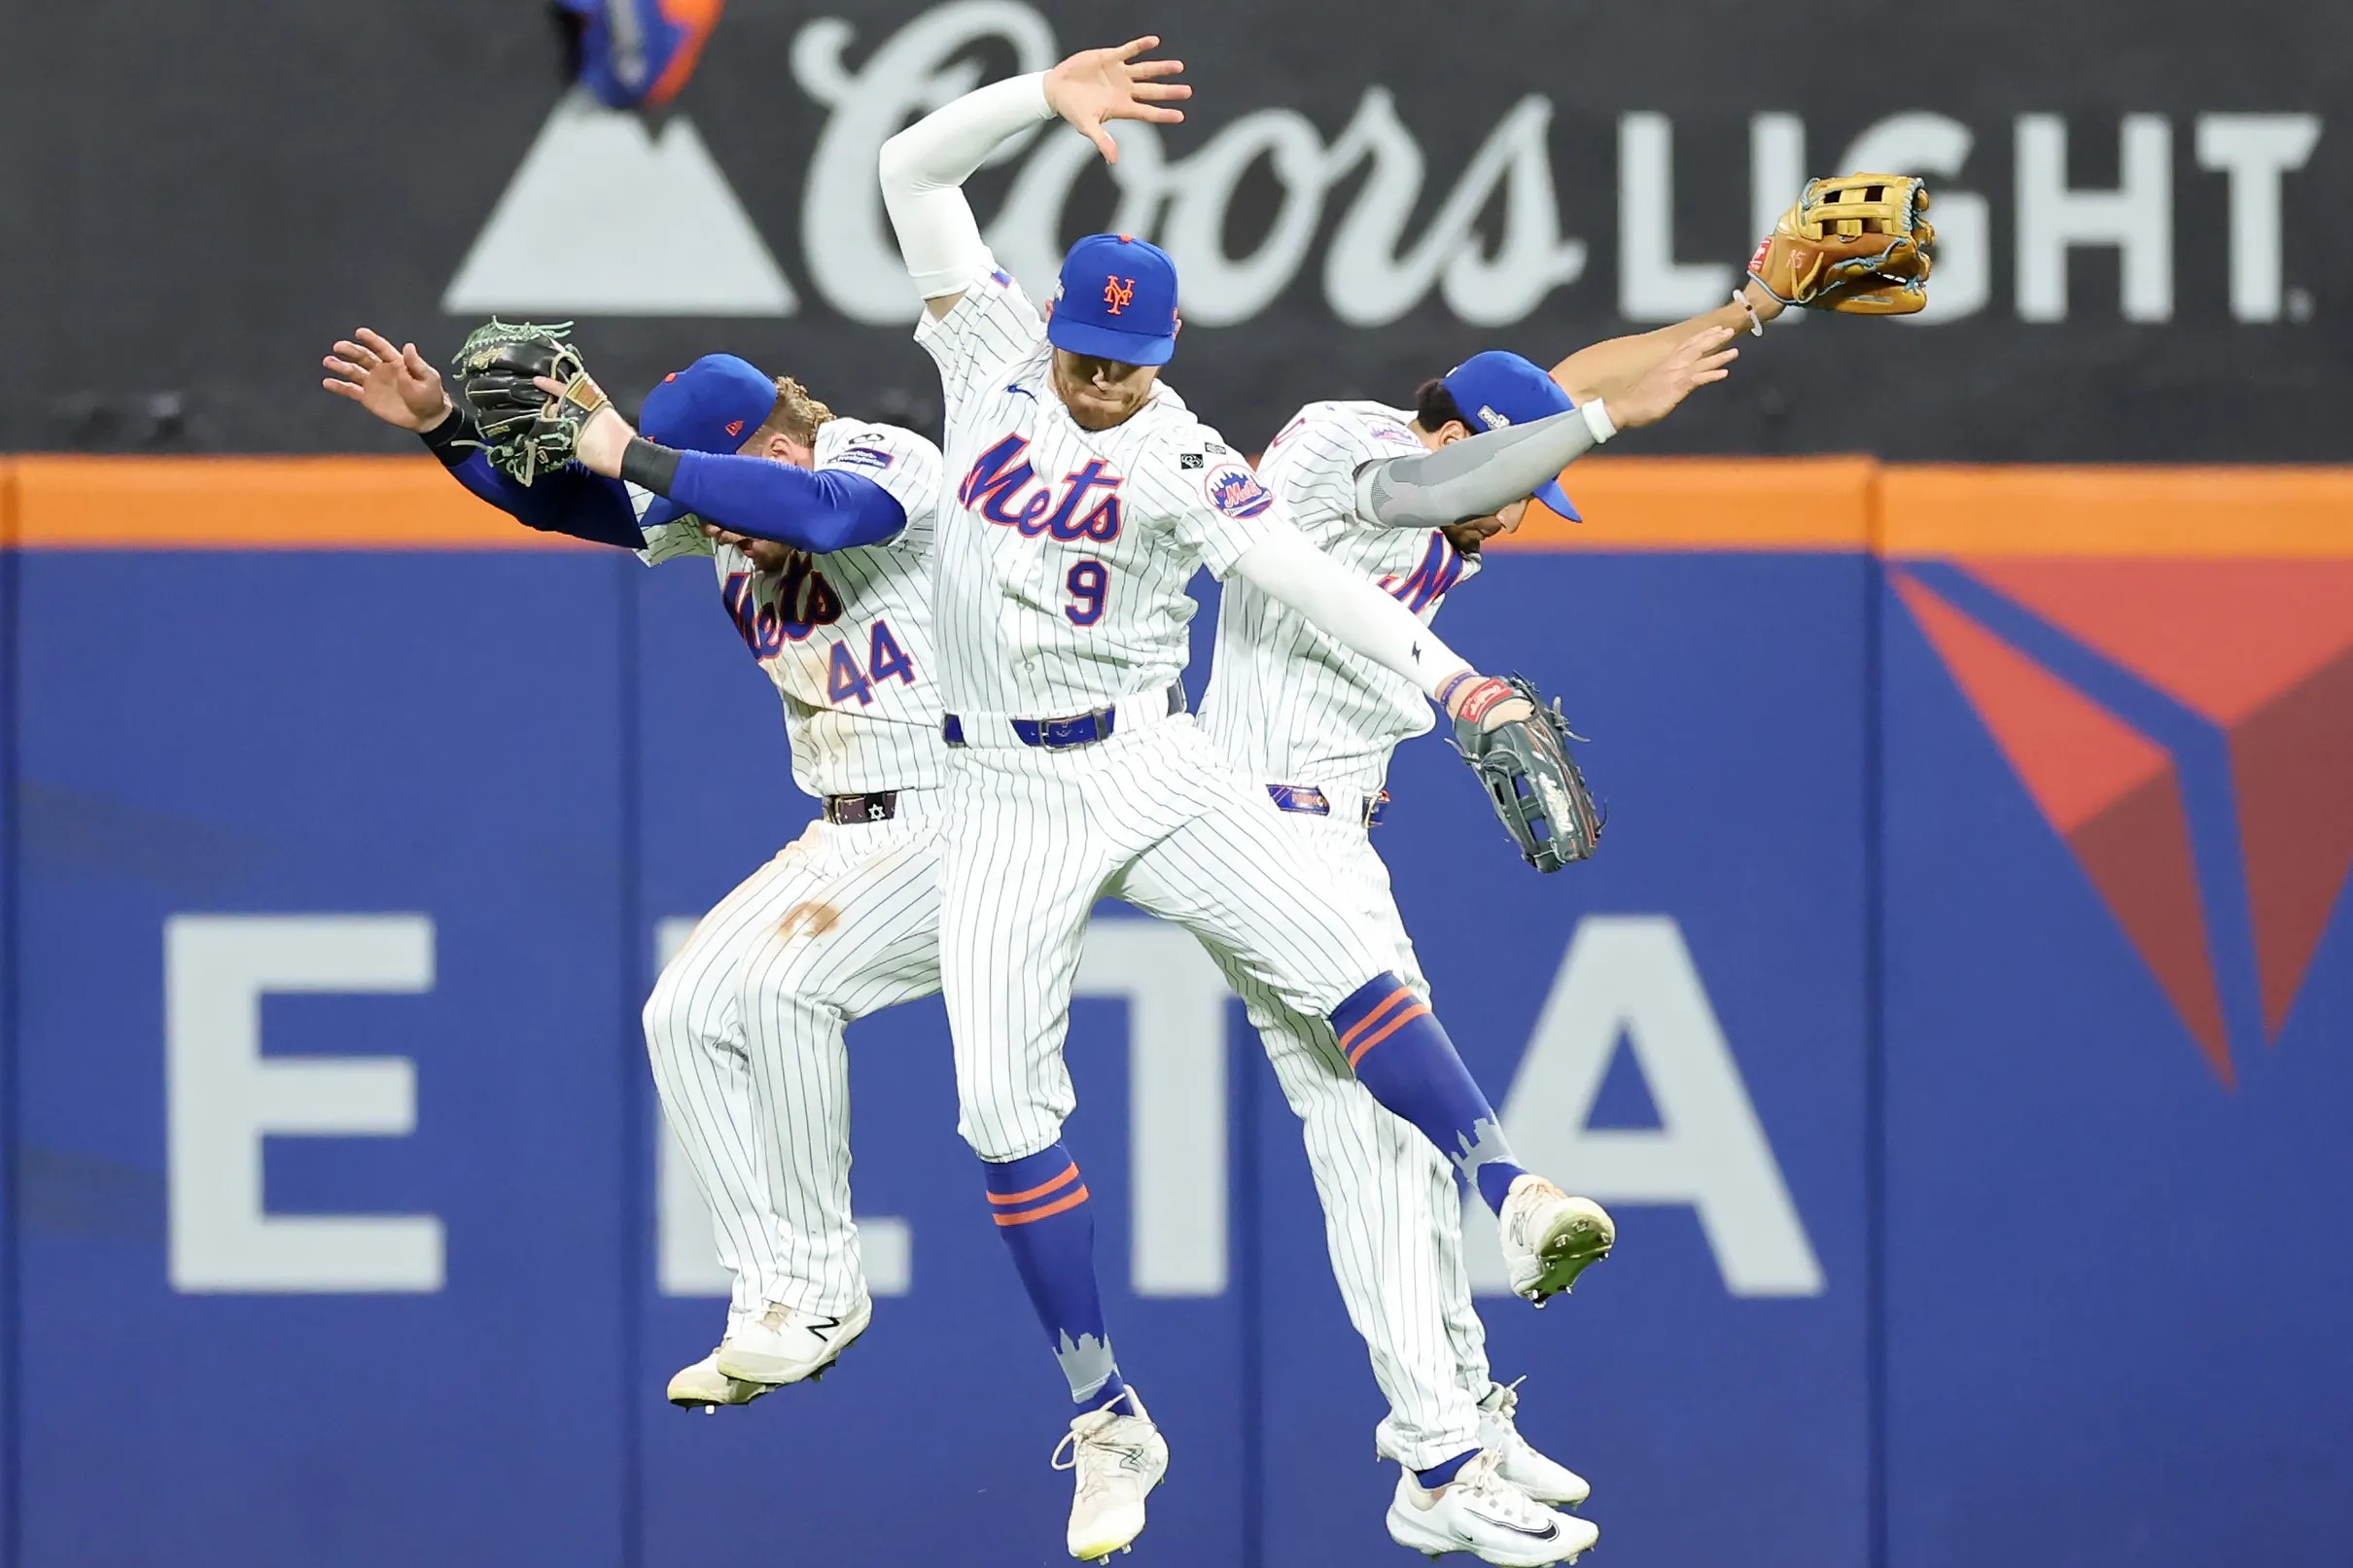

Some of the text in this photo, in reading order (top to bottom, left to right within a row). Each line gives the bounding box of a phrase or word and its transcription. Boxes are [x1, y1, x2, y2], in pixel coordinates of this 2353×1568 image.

[790, 0, 2322, 327] Coors LIGHT
[957, 432, 1125, 542] Mets
[1065, 560, 1108, 627] 9
[827, 619, 916, 707] 44
